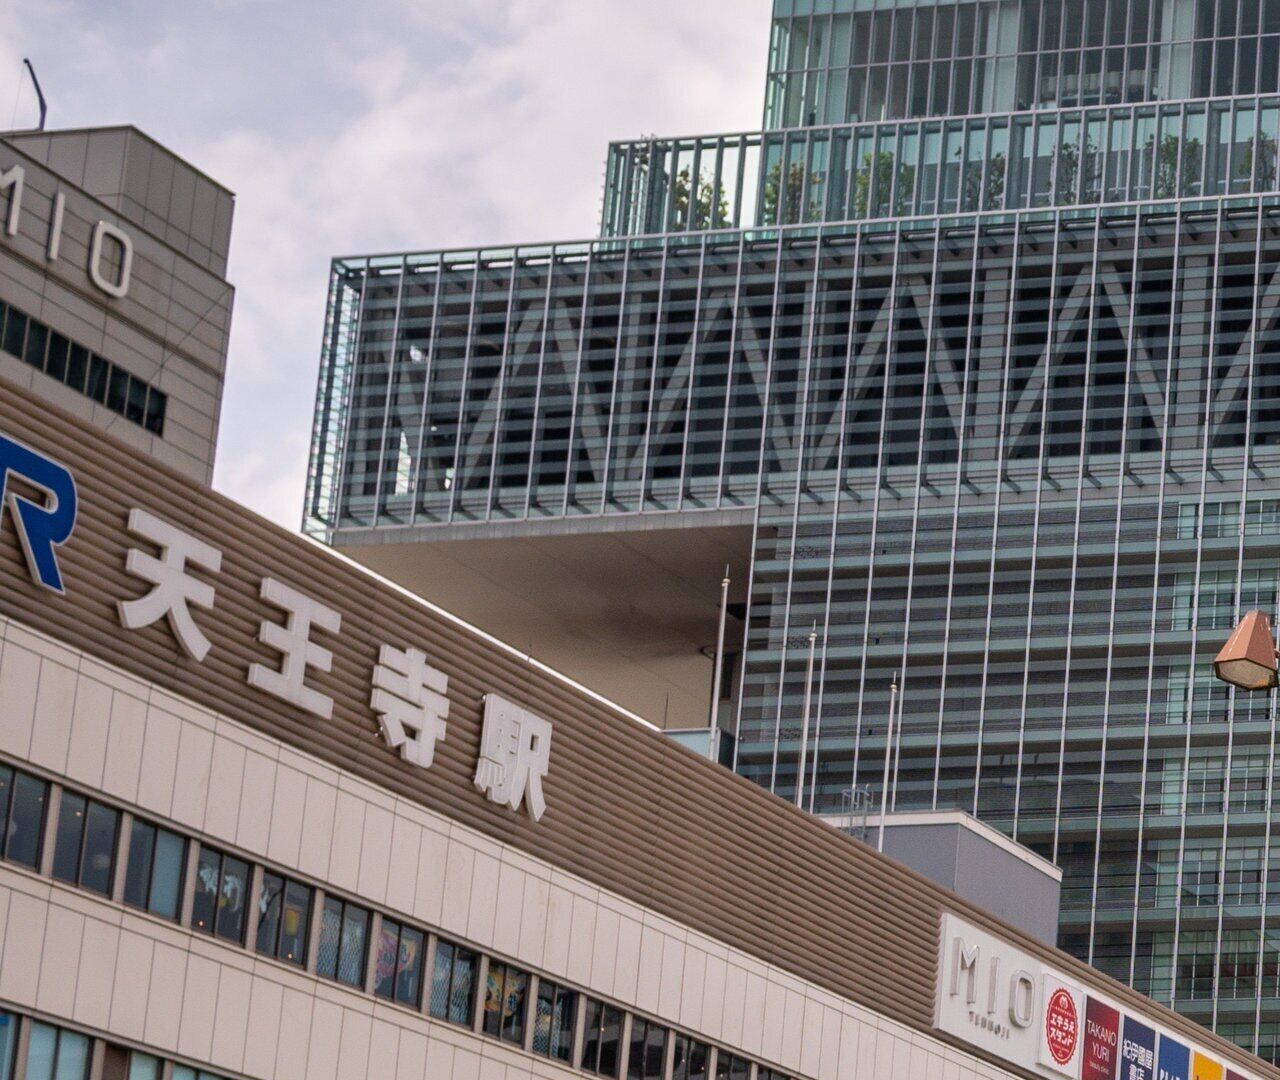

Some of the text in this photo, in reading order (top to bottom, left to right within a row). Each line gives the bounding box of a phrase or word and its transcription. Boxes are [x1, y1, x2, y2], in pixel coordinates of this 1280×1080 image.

[116, 508, 554, 823] 天王寺駅
[950, 937, 1035, 1028] MIO
[1050, 1027, 1074, 1047] スタンド
[1087, 1019, 1117, 1047] TAKANO
[1092, 1042, 1110, 1063] YURI
